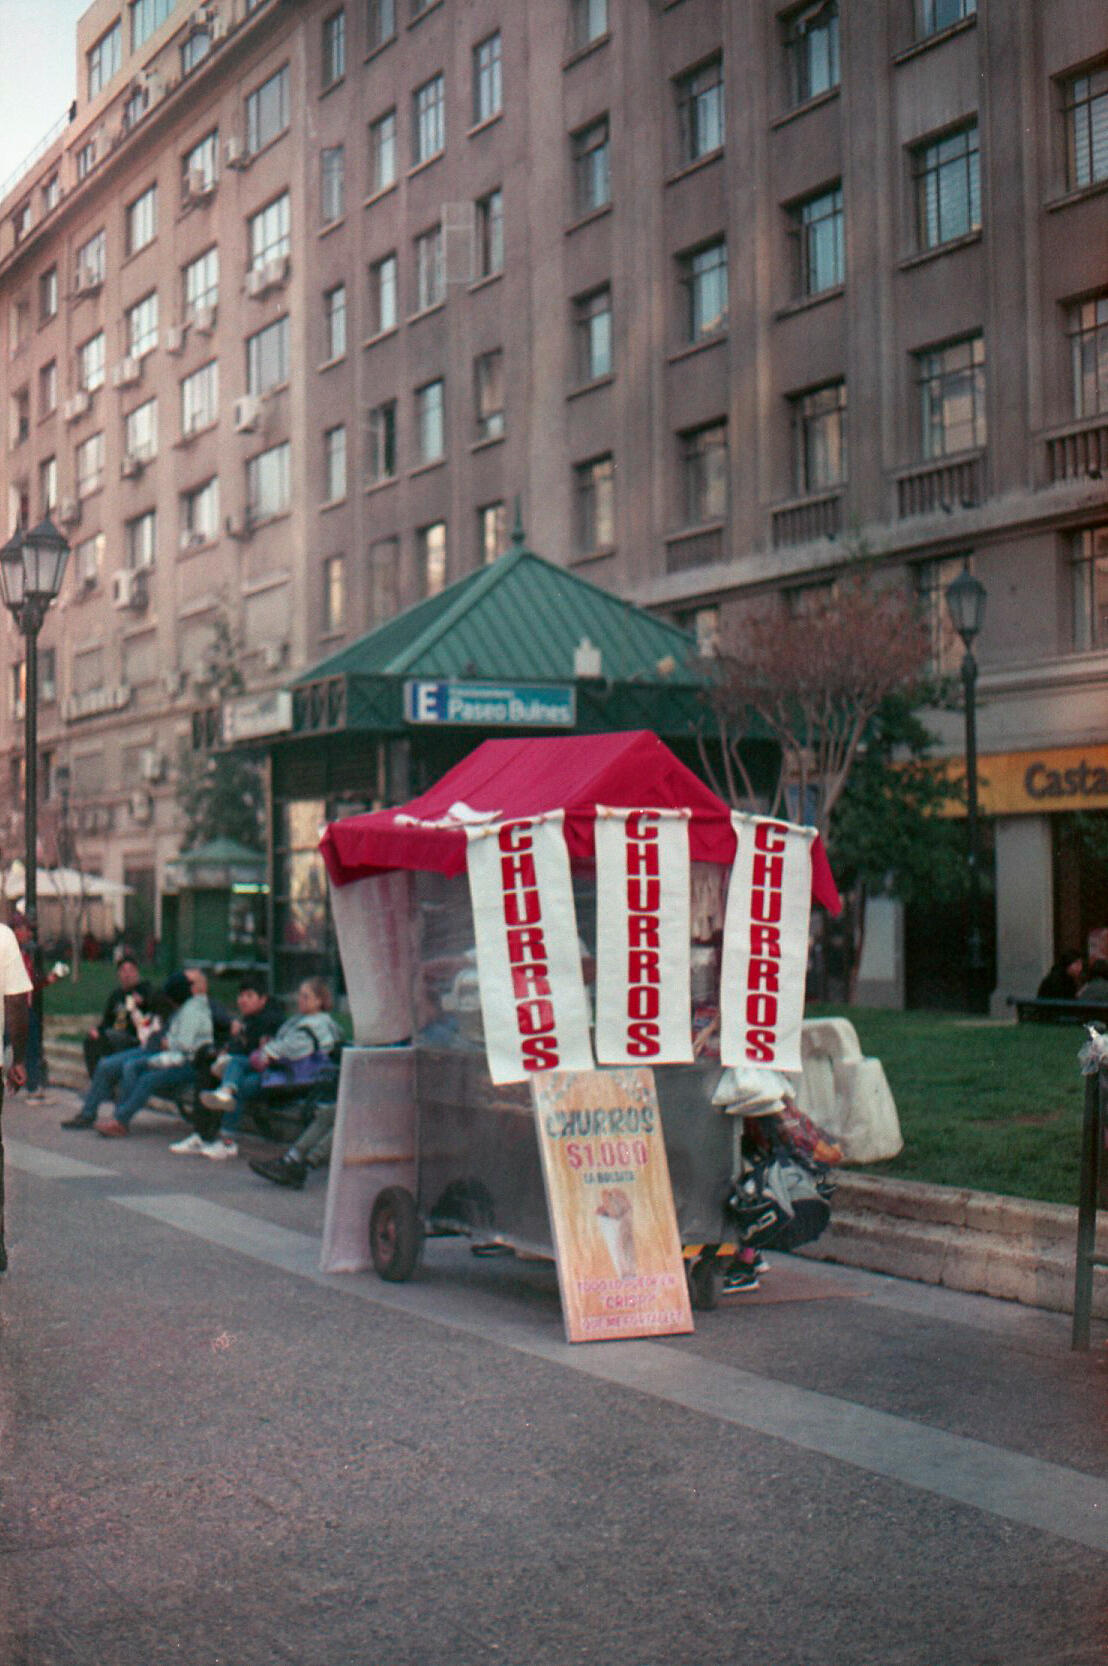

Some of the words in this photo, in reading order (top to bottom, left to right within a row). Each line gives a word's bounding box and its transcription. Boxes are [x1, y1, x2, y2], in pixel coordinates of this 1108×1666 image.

[416, 684, 439, 720] E
[498, 821, 560, 1072] CHURROS
[625, 811, 661, 1058] CHURROS
[745, 822, 789, 1064] CHURROS
[546, 1107, 655, 1138] CHURROS
